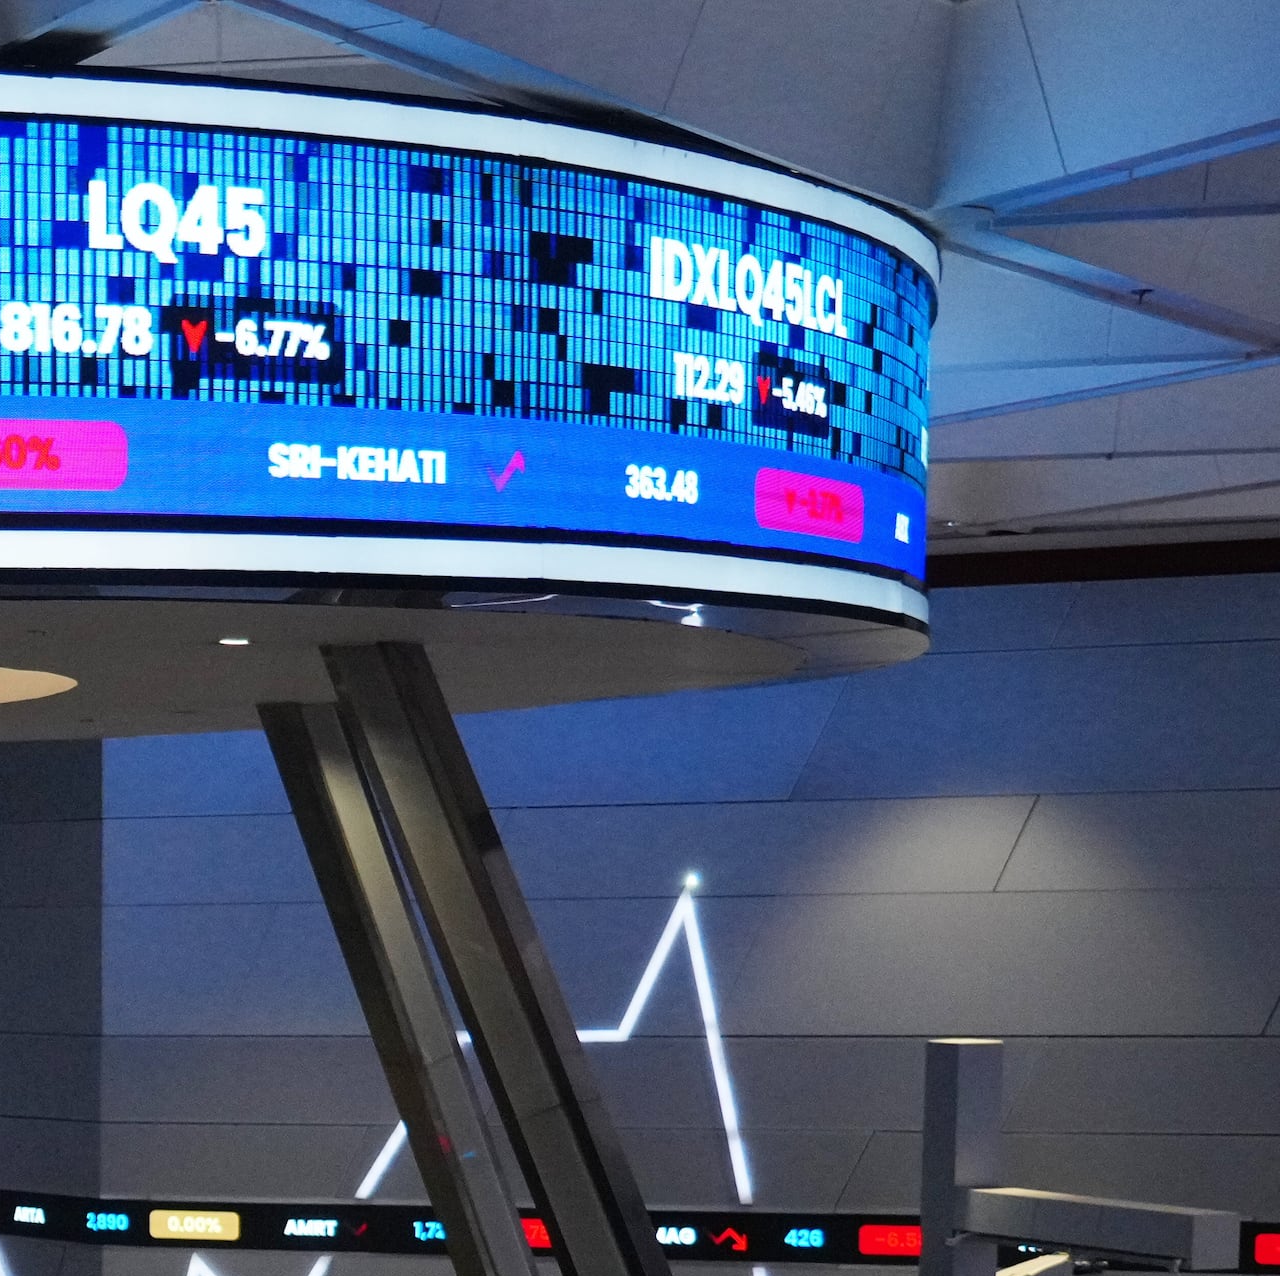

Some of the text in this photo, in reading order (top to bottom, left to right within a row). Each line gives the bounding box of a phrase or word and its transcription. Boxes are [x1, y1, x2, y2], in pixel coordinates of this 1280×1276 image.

[88, 179, 265, 263] LQ45
[650, 236, 848, 338] IDXLQ45LCL
[0, 302, 330, 360] 816.78 -6.77%
[673, 351, 745, 405] 112.29
[268, 442, 446, 485] SRI-KEHATI
[625, 465, 699, 504] 363.48
[86, 1211, 130, 1231] 2,890
[167, 1215, 222, 1234] 0.00%
[283, 1219, 338, 1237] AMRT
[784, 1228, 824, 1248] 426
